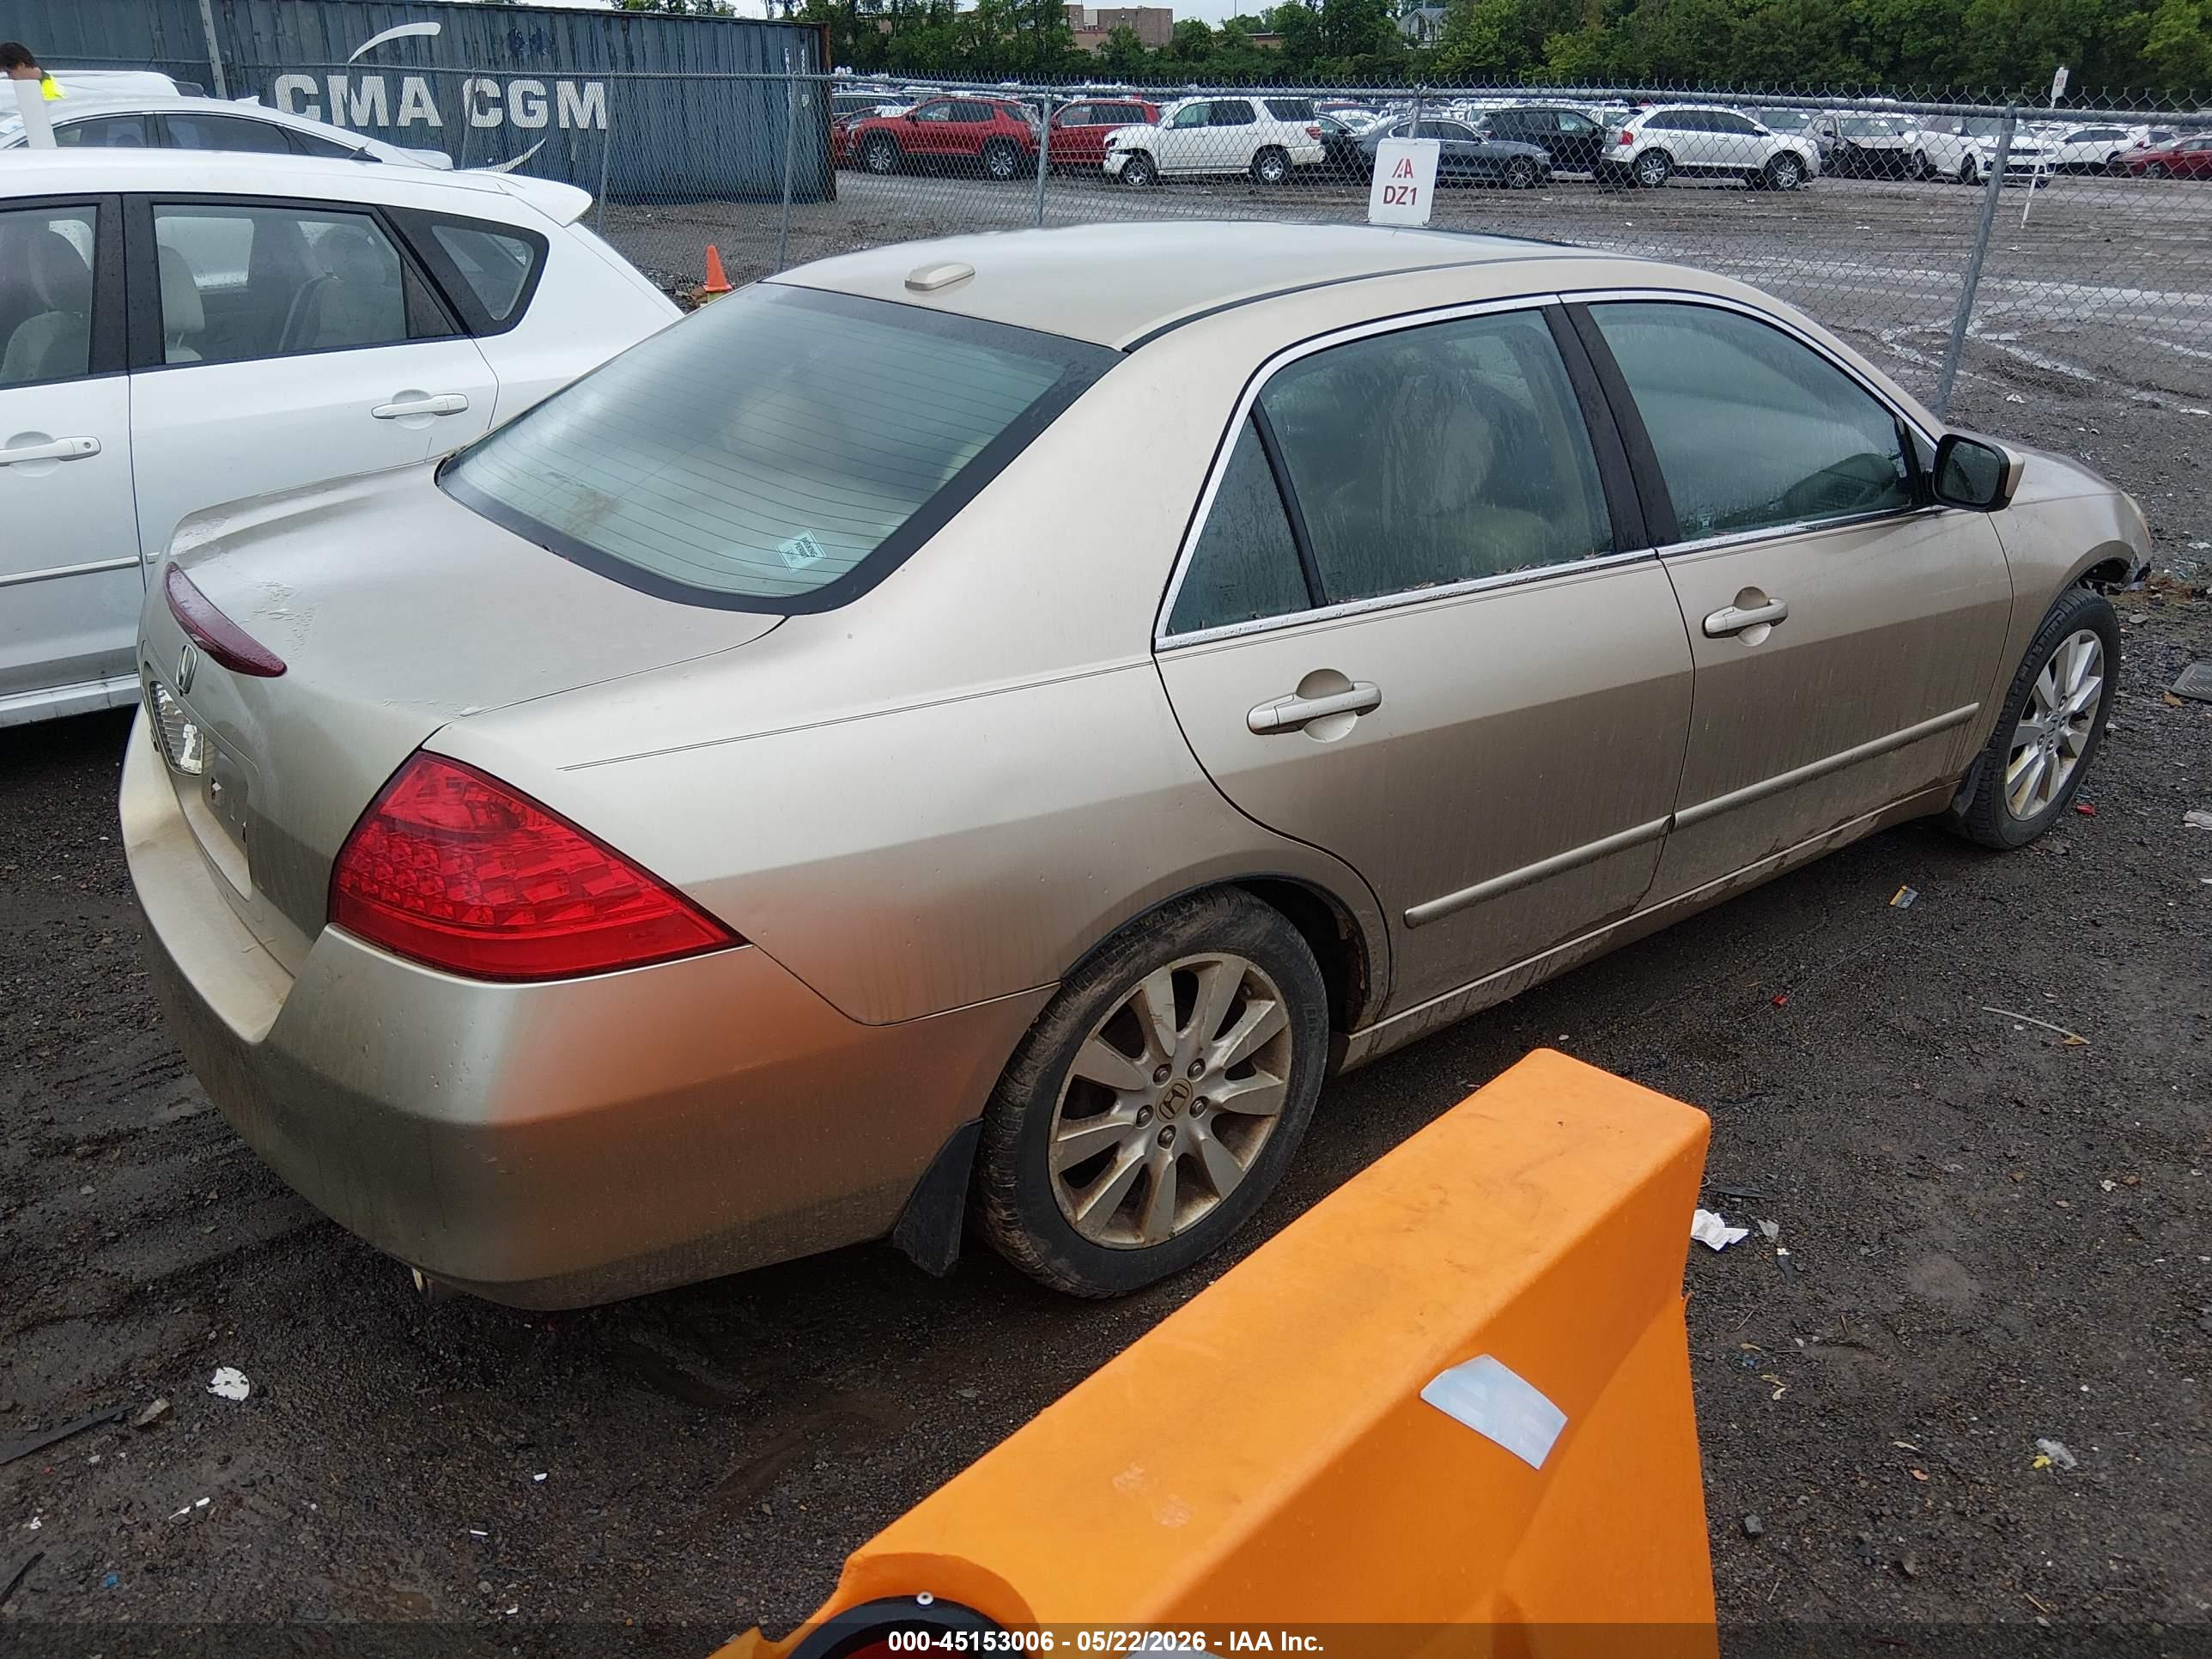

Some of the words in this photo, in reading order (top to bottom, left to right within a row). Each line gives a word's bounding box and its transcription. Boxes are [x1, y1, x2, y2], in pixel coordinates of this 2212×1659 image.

[274, 74, 444, 127] CMA
[462, 78, 607, 130] CGM
[1382, 185, 1419, 206] DZ1
